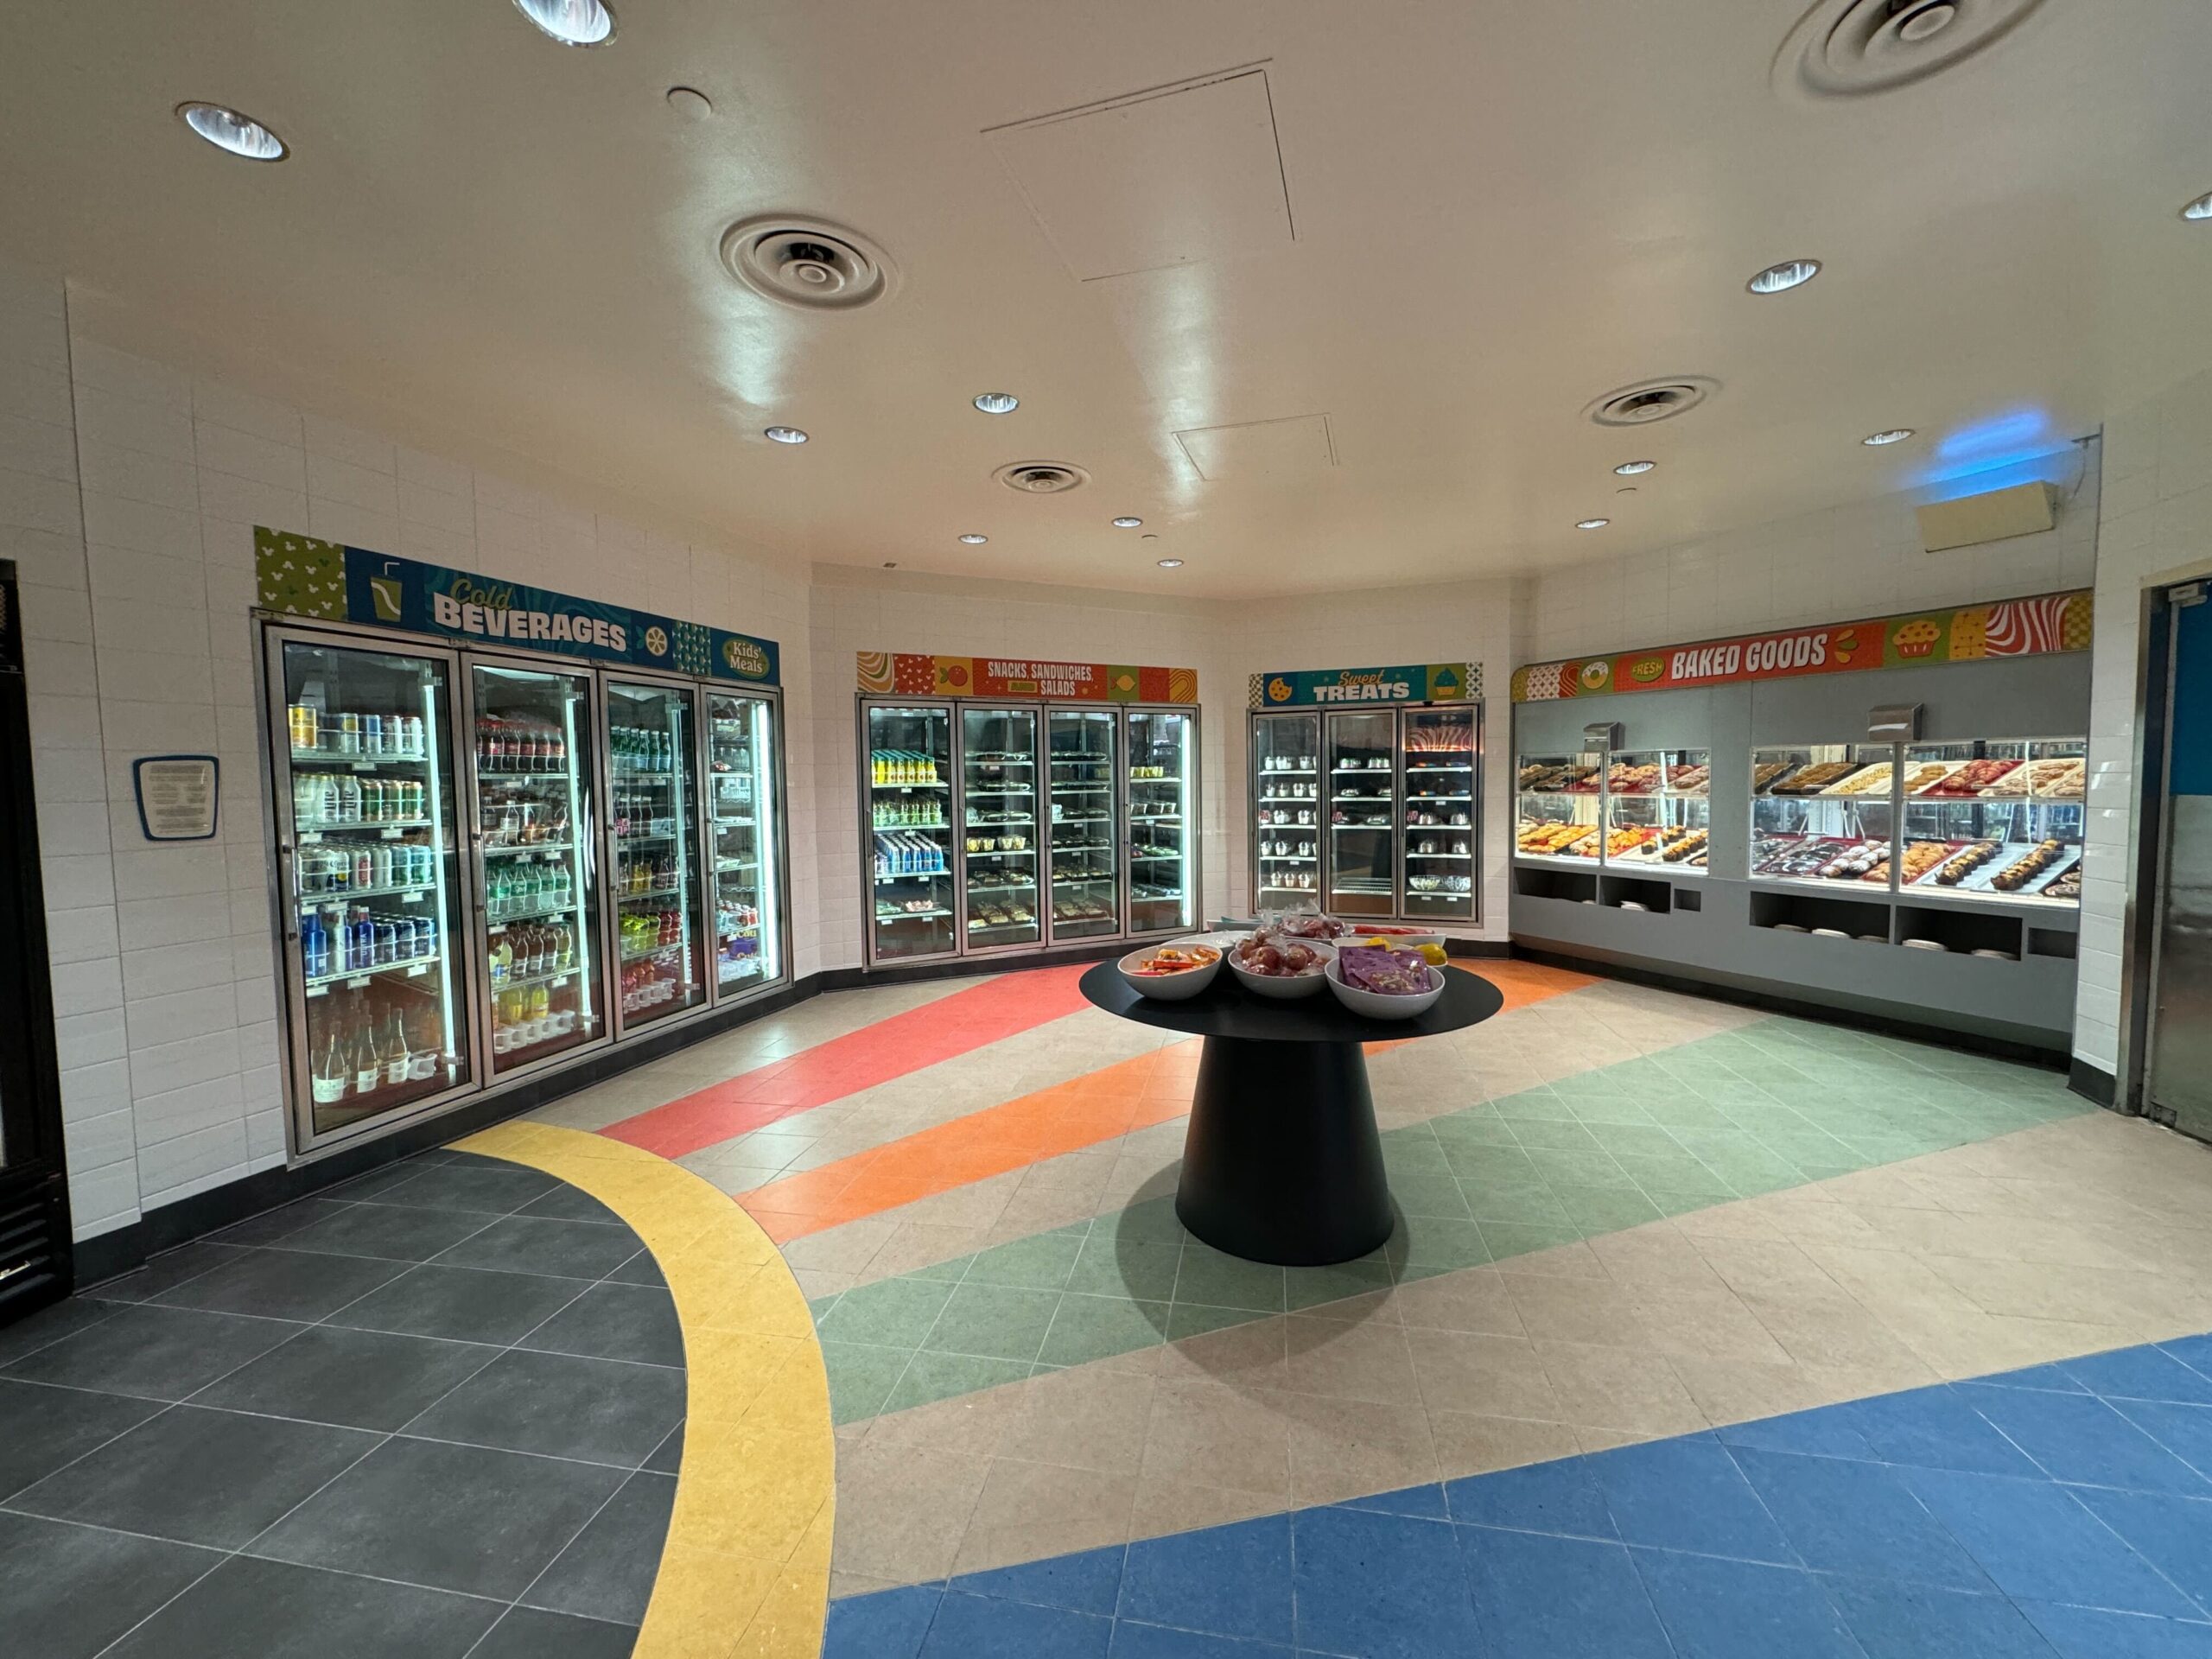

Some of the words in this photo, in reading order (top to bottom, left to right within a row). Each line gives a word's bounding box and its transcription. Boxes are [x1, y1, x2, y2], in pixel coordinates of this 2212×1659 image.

[449, 578, 512, 610] Cold
[434, 592, 626, 652] BEVERAGES
[733, 641, 761, 659] Kids'
[1671, 645, 1740, 680] BAKED
[1745, 633, 1827, 672] GOODS
[730, 655, 763, 673] Meals
[988, 661, 1029, 680] SNACKS,
[1031, 664, 1094, 683] SANDWICHES,
[1631, 660, 1662, 676] FRESH
[1040, 679, 1076, 696] SALADS
[1338, 669, 1385, 687] Sweet
[1313, 682, 1410, 702] TREATS
